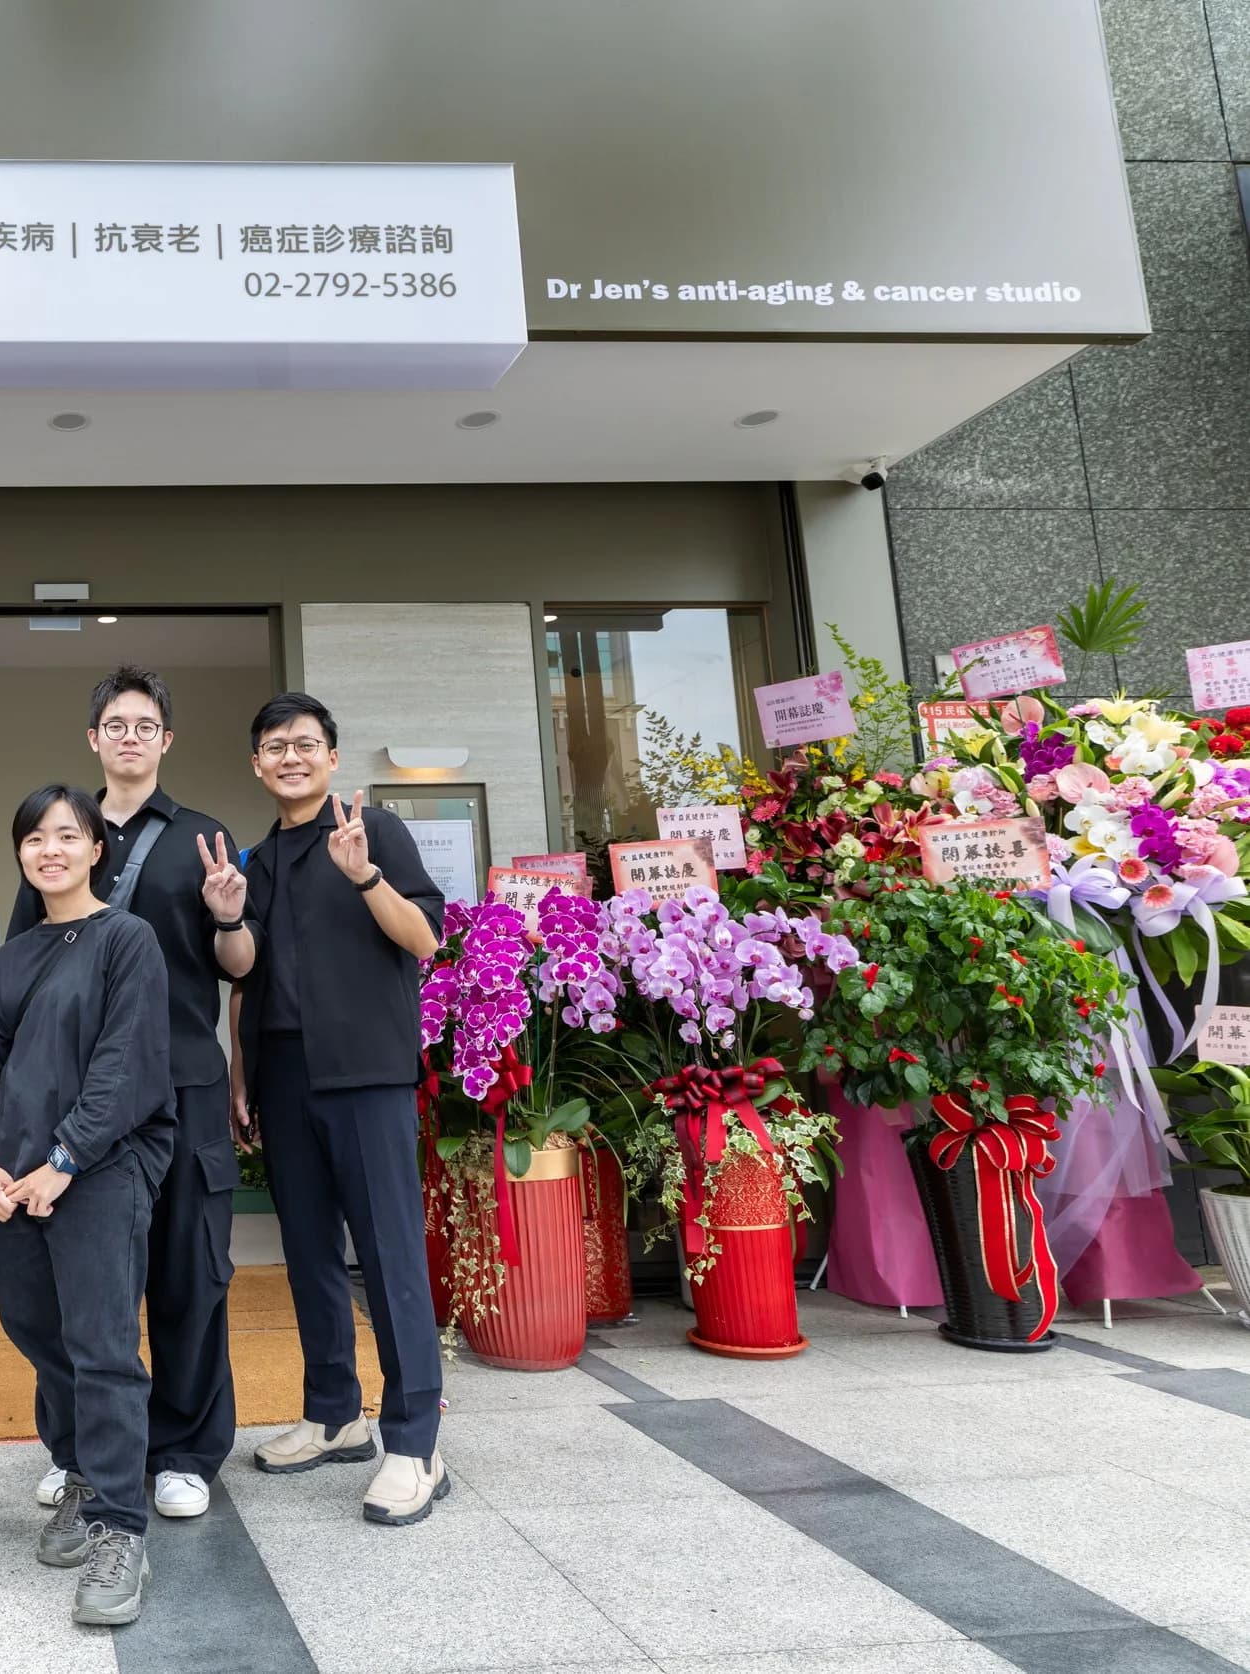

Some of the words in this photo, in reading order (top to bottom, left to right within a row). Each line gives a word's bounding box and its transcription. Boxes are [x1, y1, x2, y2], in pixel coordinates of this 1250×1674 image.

[94, 223, 201, 255] 抗衰老
[240, 223, 454, 255] 癌症診療諮詢
[243, 271, 457, 298] 02-2792-5386
[546, 278, 582, 299] Dr
[677, 280, 834, 306] anti-aging
[841, 281, 866, 302] &
[873, 284, 977, 302] cancer
[986, 281, 1082, 303] studio
[941, 839, 1028, 862] 開幕誌喜
[508, 874, 575, 888] 益民健康診所
[630, 862, 698, 882] 開幕誌慶
[504, 891, 537, 910] 開業
[1208, 1025, 1250, 1041] 開幕
